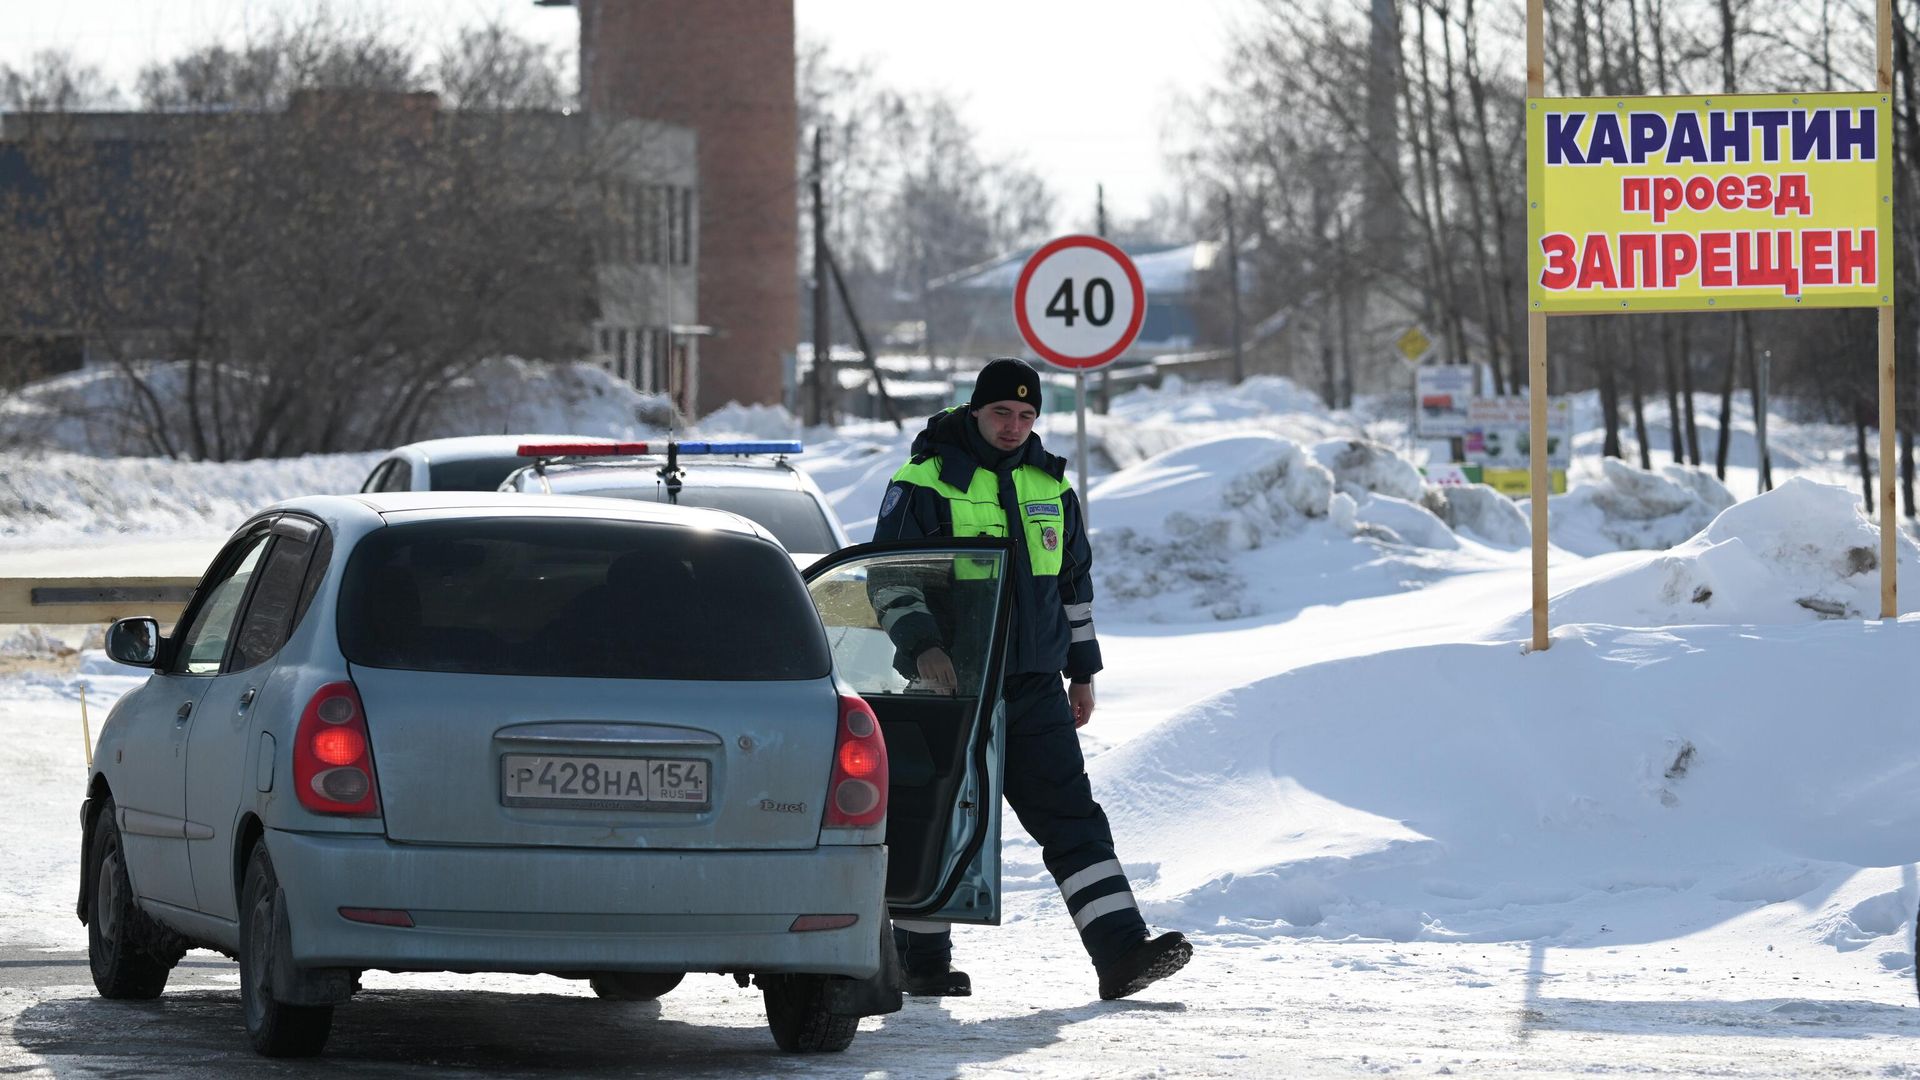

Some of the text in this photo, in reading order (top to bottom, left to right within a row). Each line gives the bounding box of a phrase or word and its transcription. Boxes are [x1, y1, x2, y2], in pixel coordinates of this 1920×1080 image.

[1546, 109, 1876, 164] КАРАНТИН
[1622, 174, 1812, 223] проезд
[1540, 230, 1876, 295] ЗАПРЕЩЕН
[1045, 277, 1114, 327] 40
[652, 763, 701, 788] 154
[660, 788, 685, 800] RUS
[760, 799, 808, 814] Duet
